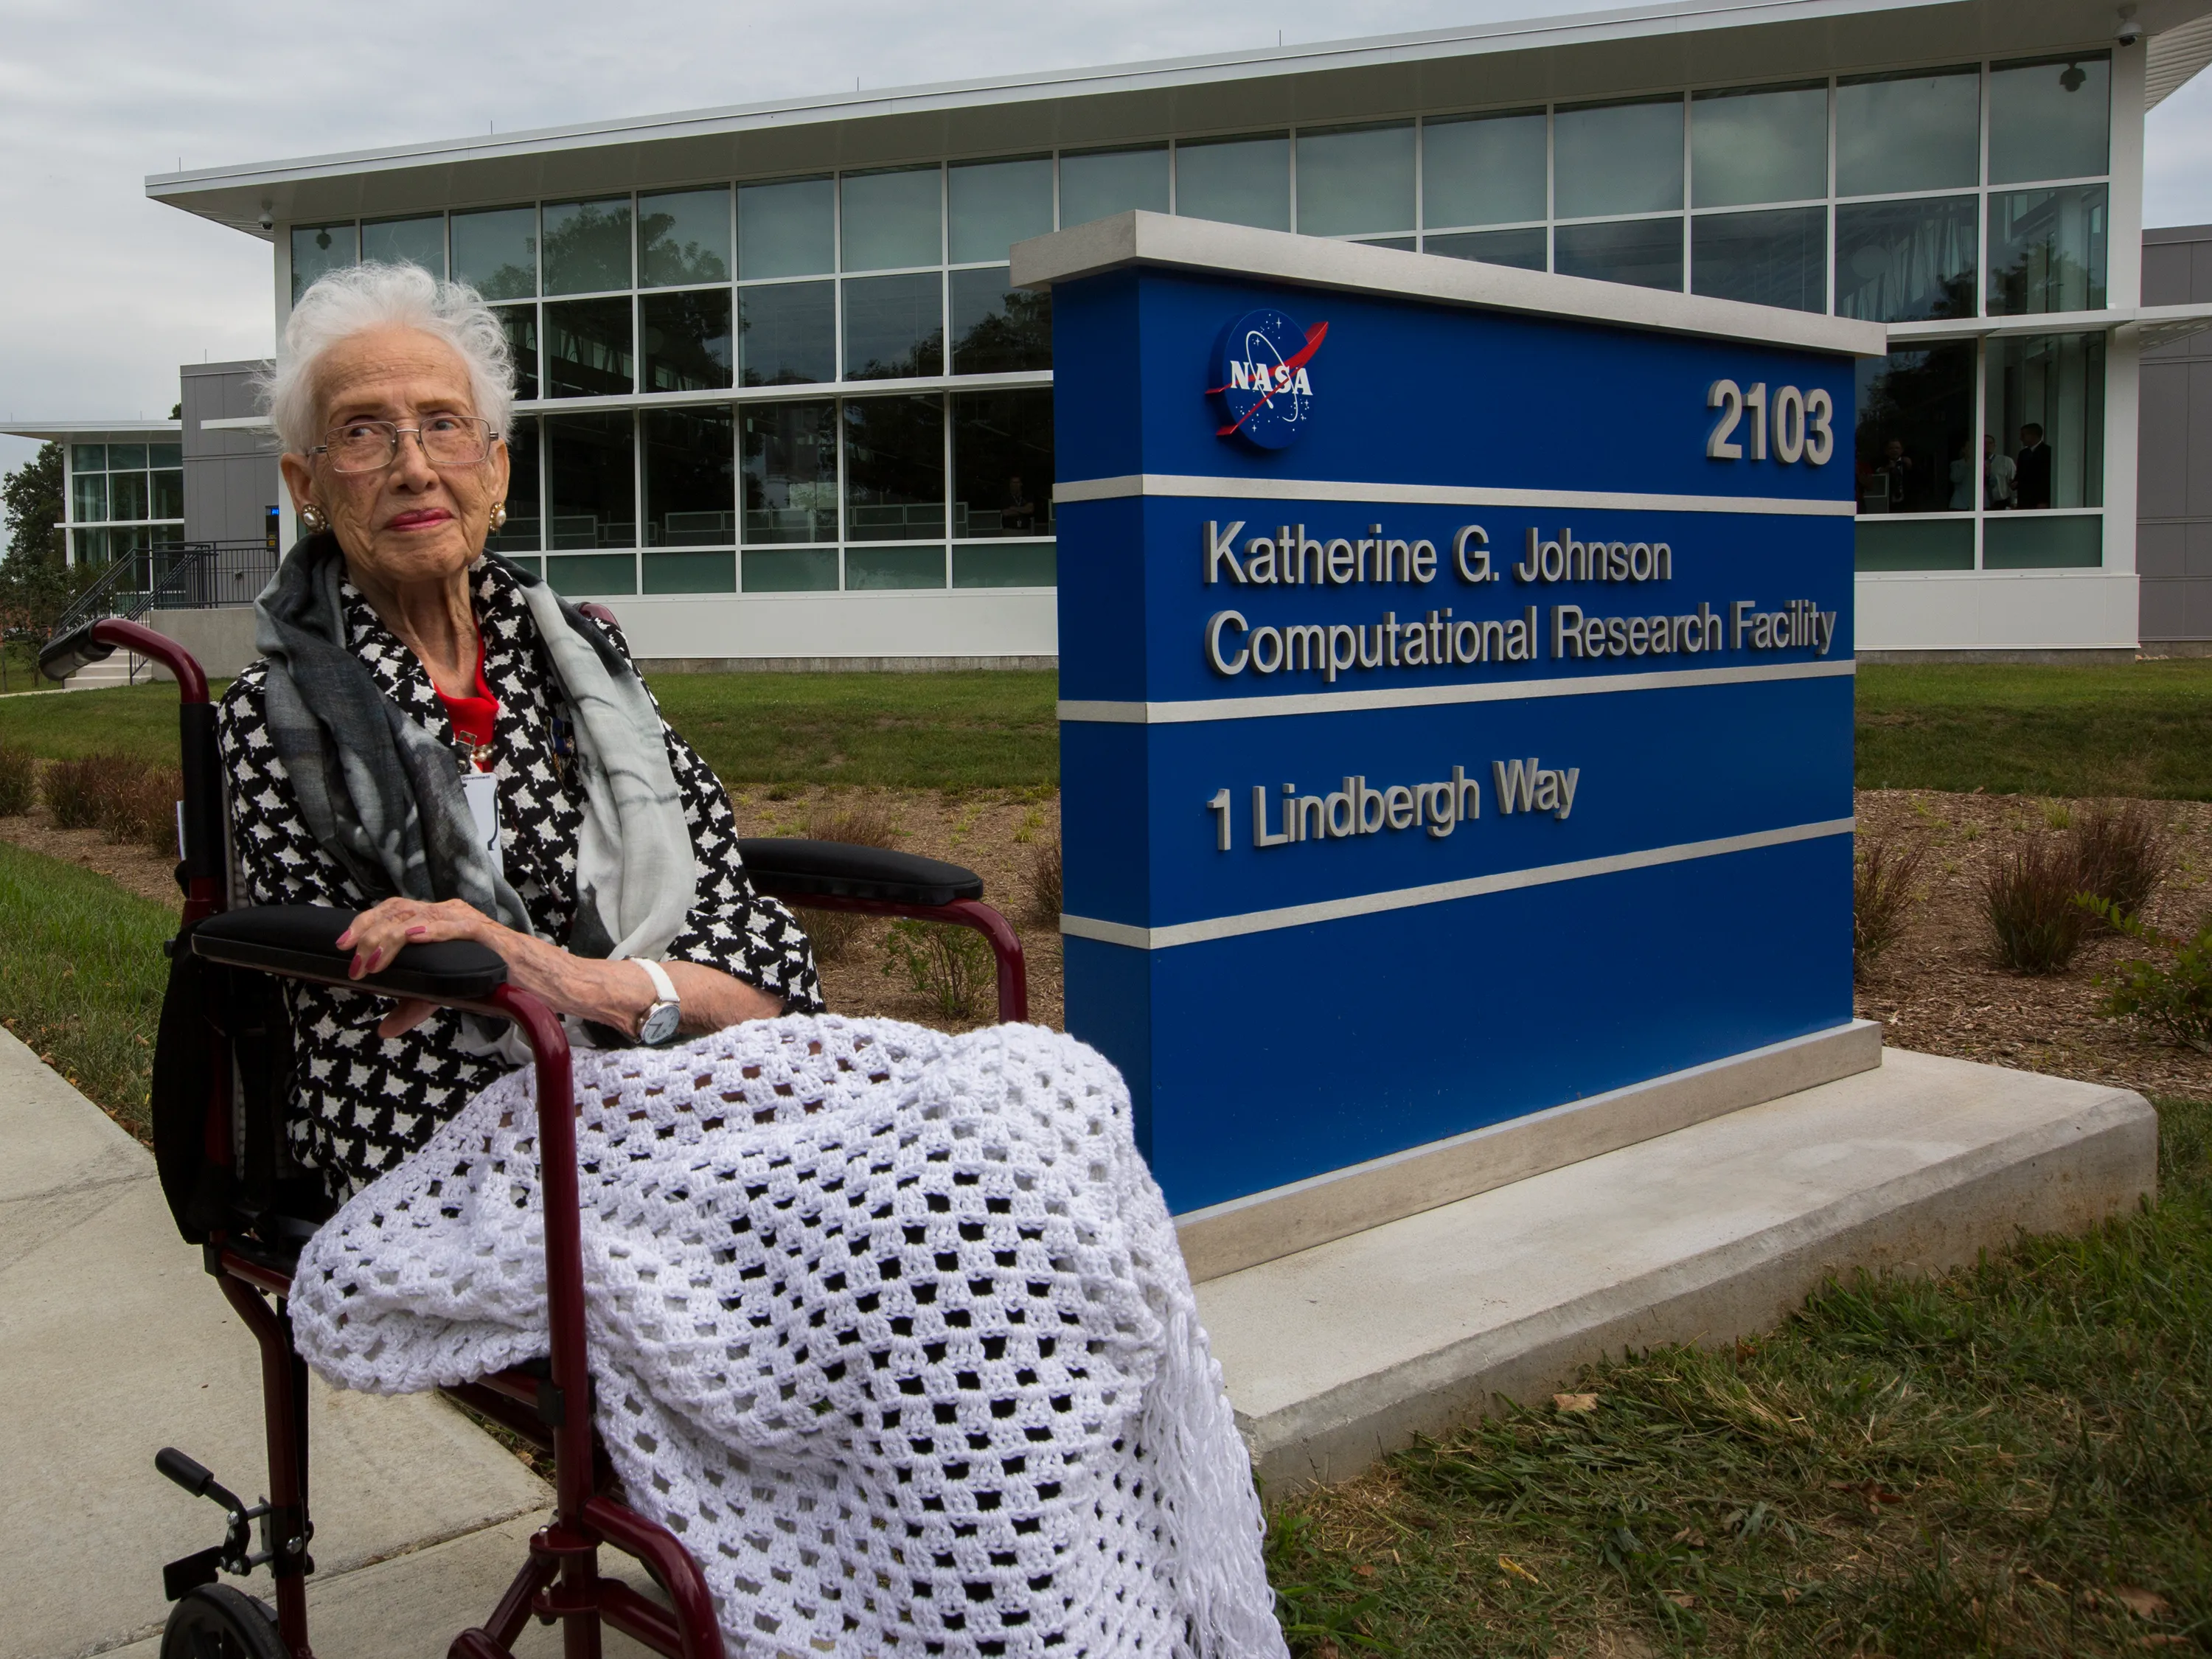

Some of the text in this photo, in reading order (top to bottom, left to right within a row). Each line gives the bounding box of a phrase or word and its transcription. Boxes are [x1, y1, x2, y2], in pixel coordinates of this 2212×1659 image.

[1230, 361, 1313, 395] NASA
[1706, 379, 1834, 465] 2103
[1203, 521, 1672, 584] Katherine G. Johnson
[1205, 599, 1837, 682] Computational Research Facility
[1207, 757, 1580, 850] 1 Lindbergh Way
